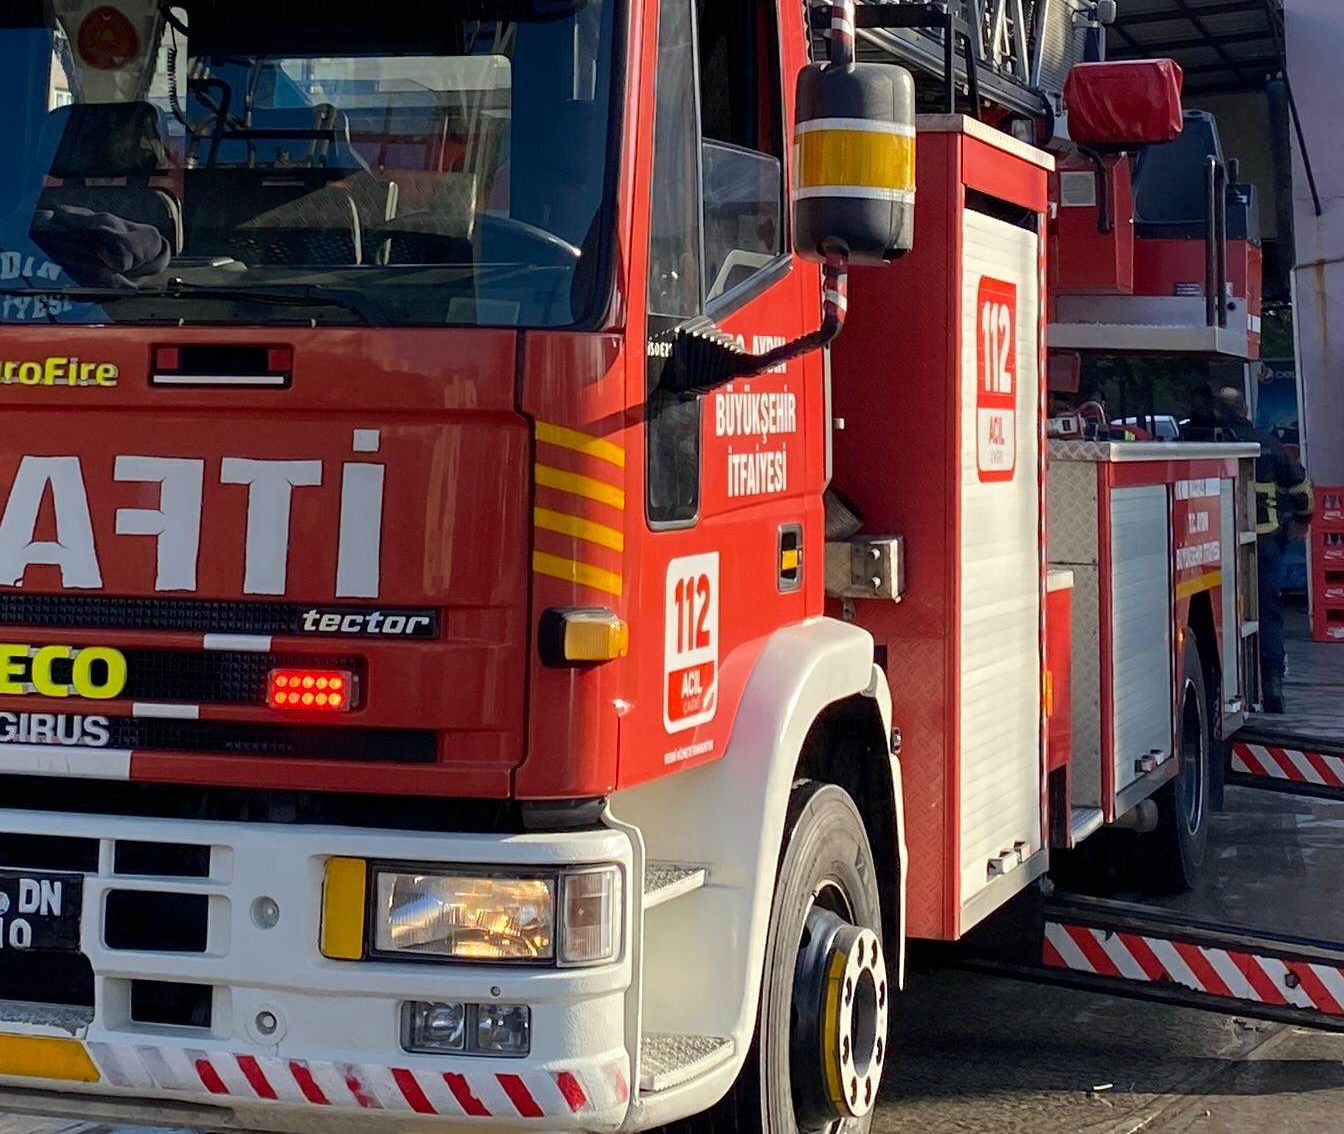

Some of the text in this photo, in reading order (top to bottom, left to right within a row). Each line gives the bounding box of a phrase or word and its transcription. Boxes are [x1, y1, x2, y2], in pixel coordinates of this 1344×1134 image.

[982, 301, 1012, 395] 112
[716, 385, 797, 445] BÜYÜKŞEHİR
[728, 442, 788, 497] İTFAİYESİ
[301, 609, 431, 635] tector
[674, 573, 711, 654] 112
[18, 878, 62, 916] DN
